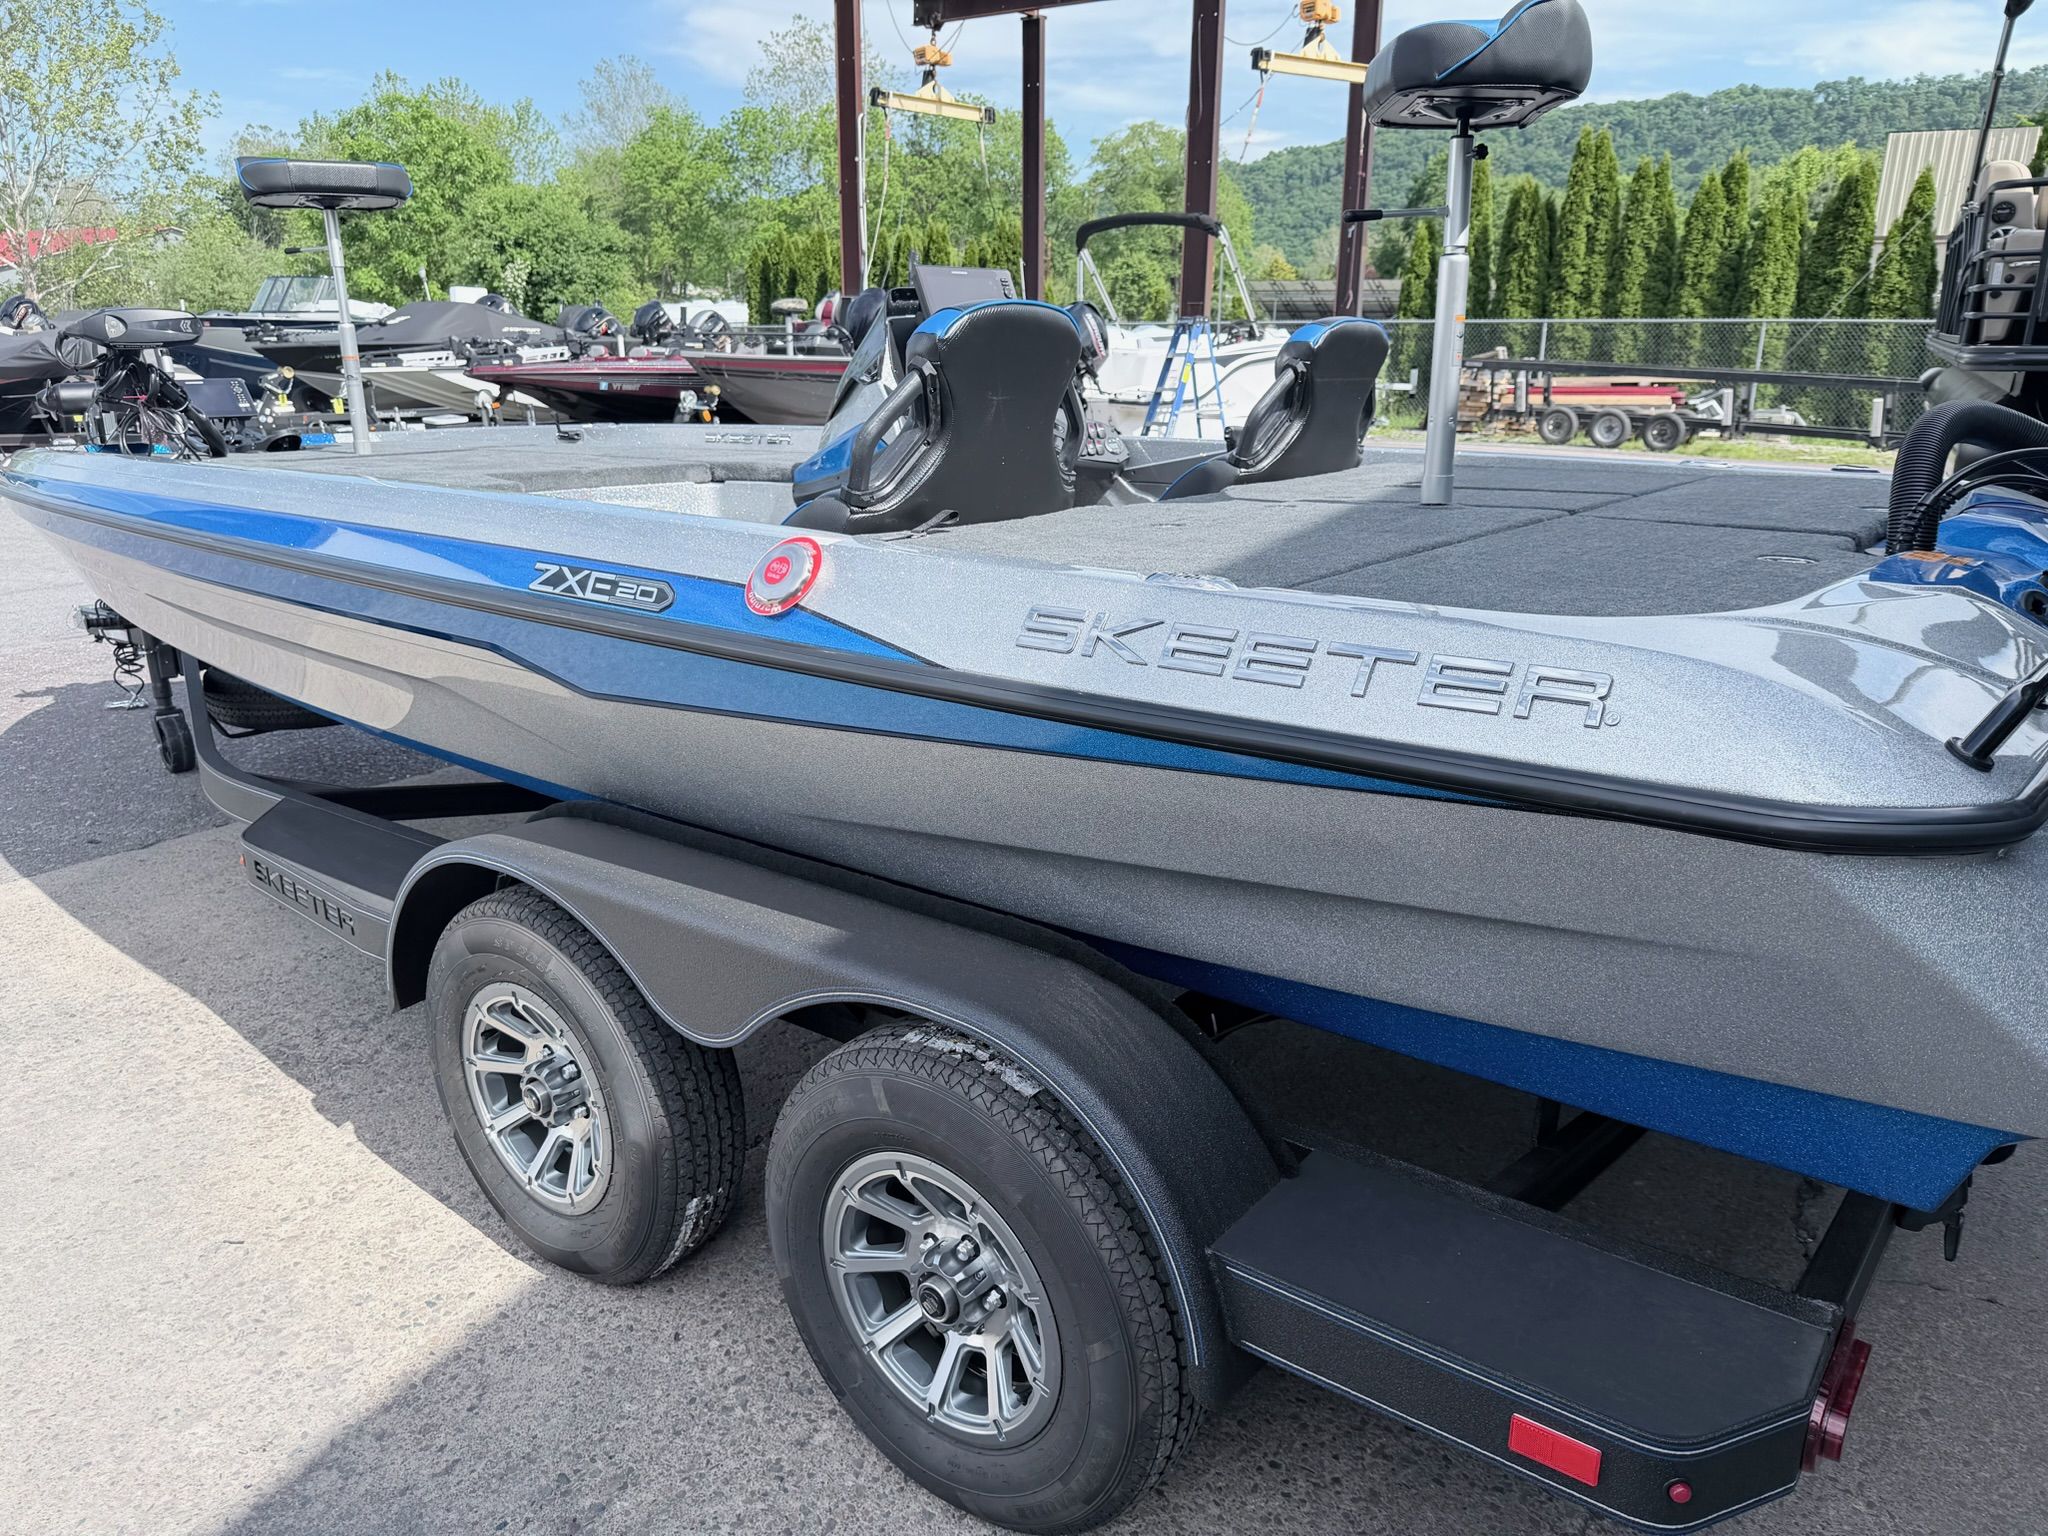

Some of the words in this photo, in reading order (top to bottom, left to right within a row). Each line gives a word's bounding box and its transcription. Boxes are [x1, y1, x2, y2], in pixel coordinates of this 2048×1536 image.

[705, 433, 792, 445] SKEETER
[748, 592, 781, 613] Warning
[254, 860, 355, 936] SKEETER
